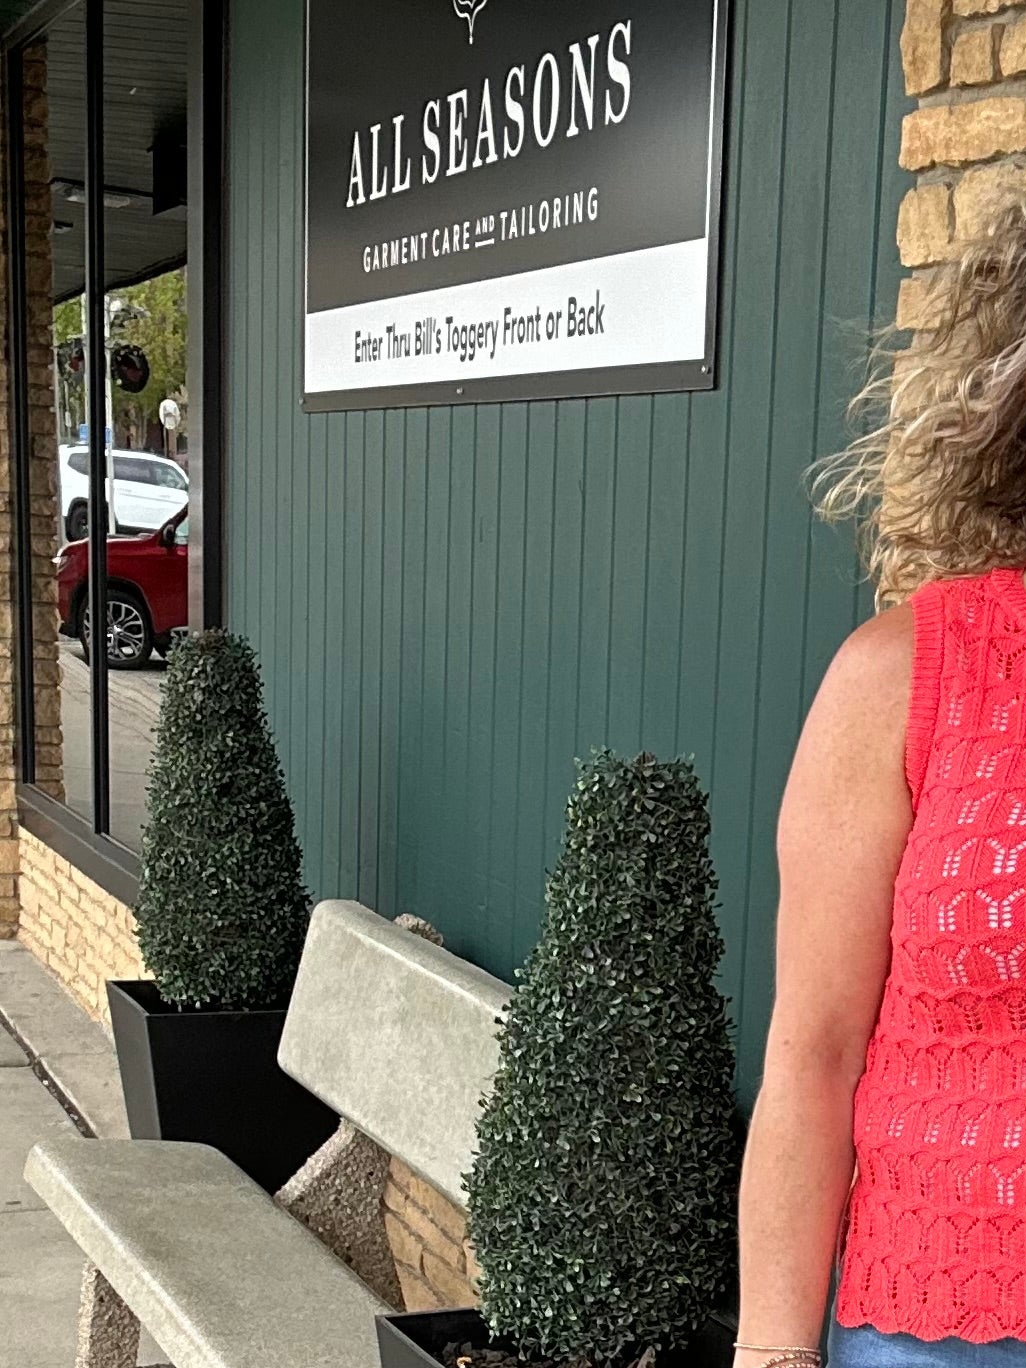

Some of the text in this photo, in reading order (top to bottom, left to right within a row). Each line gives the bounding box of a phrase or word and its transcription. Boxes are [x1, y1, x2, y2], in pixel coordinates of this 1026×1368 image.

[346, 19, 632, 208] ALL SEASONS
[363, 186, 598, 273] GARMENT CARE AND TAILORING
[354, 288, 605, 363] Enter Thru Bill's Toggery Front or Back
